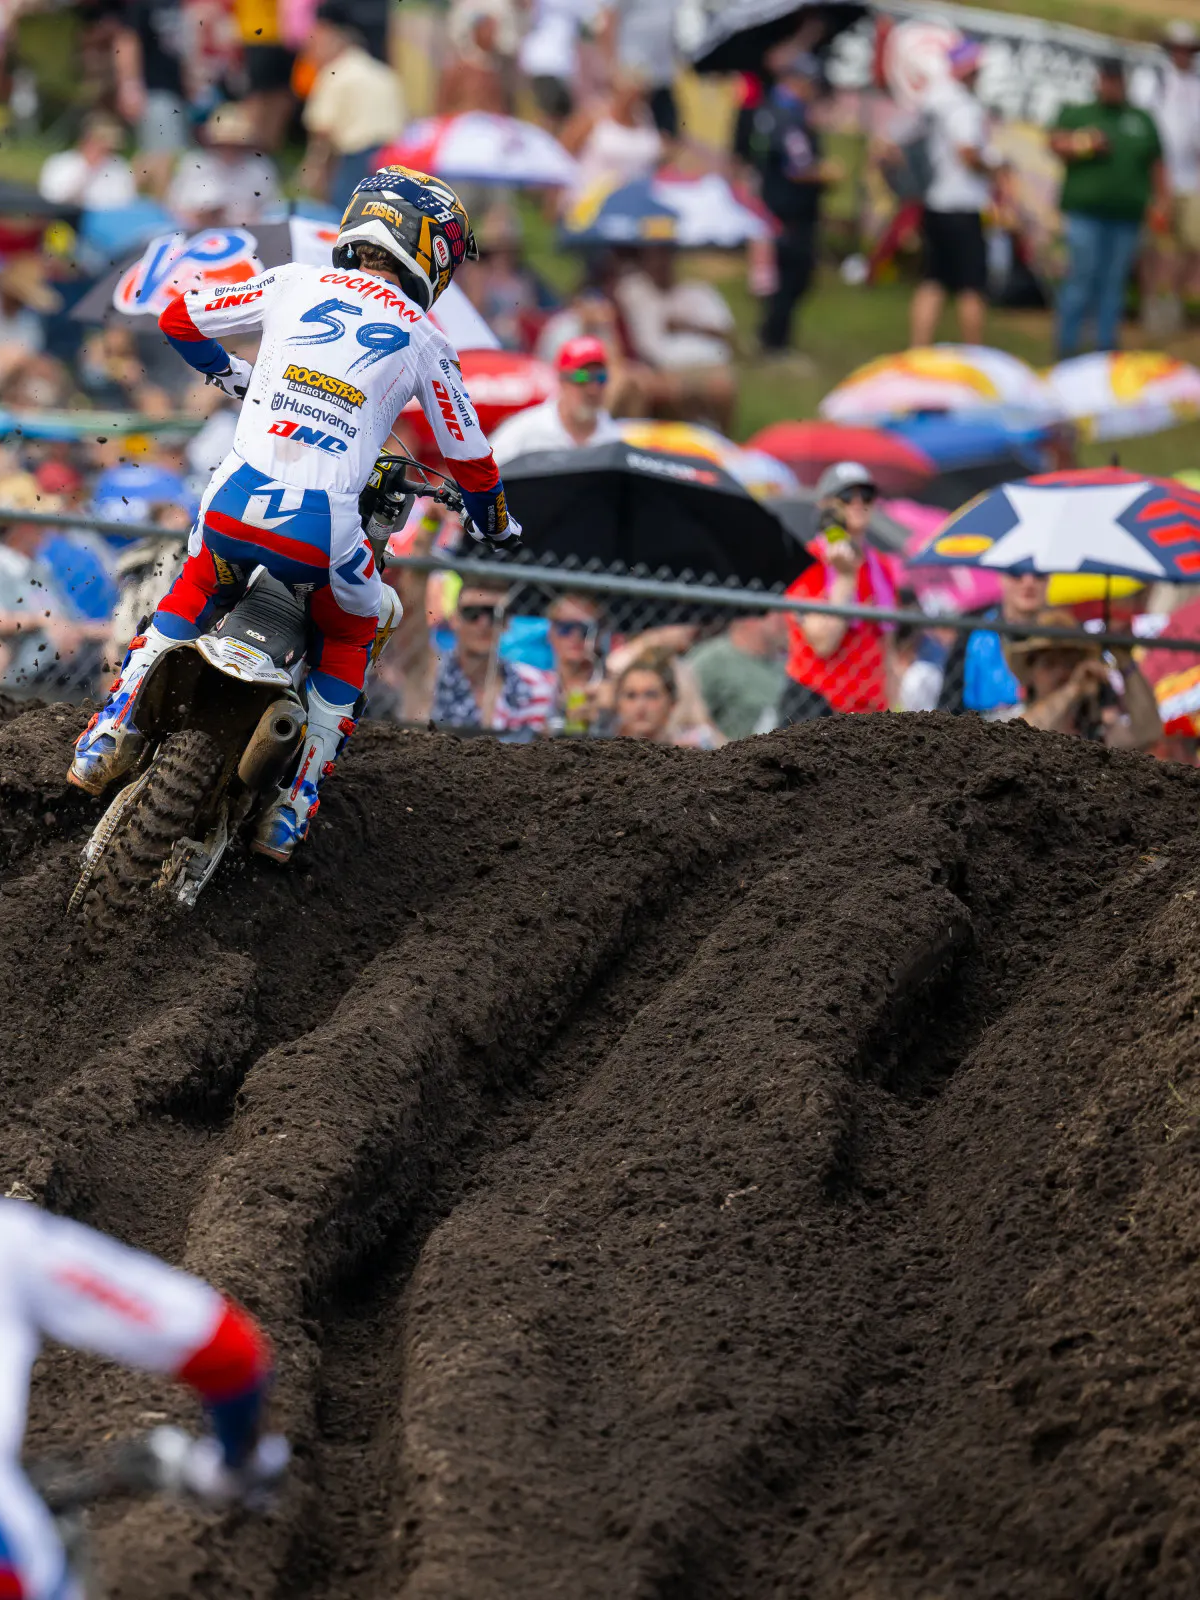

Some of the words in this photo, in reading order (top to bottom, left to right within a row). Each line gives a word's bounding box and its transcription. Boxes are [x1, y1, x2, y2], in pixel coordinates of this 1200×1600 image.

[361, 201, 403, 228] CASEY
[436, 240, 448, 264] BELL
[319, 273, 423, 323] COCHRAN
[283, 297, 411, 378] 59
[282, 364, 367, 410] ROCKSTAR
[288, 382, 326, 400] ENERGY
[324, 391, 354, 415] DRINK
[283, 396, 358, 439] Husqvarna
